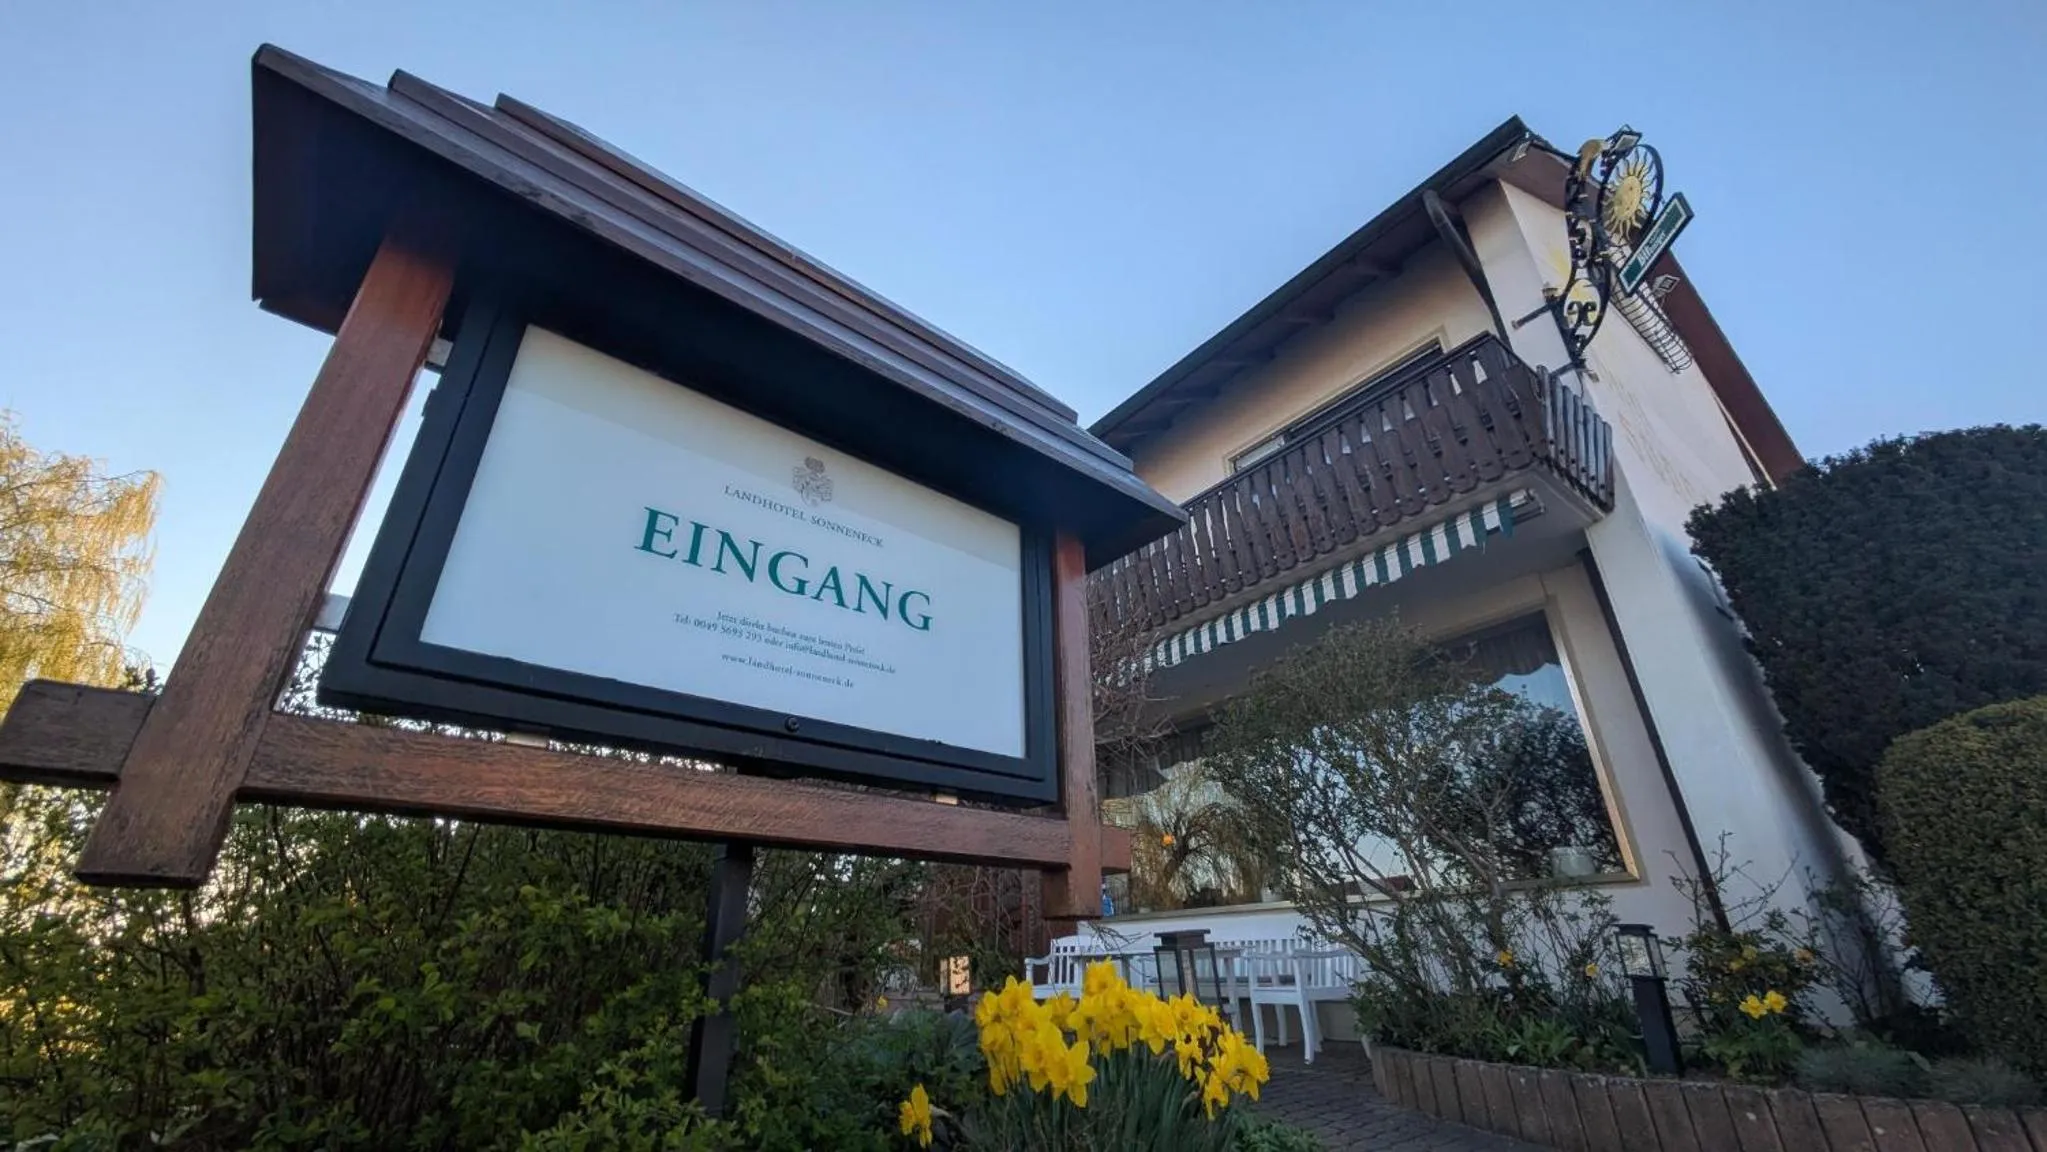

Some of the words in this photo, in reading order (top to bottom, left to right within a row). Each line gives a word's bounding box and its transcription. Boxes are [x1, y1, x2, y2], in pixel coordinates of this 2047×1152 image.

[724, 485, 807, 521] LANDHOTEL
[810, 515, 884, 548] SONNENECK
[633, 506, 934, 631] EINGANG
[764, 635, 784, 649] oder
[721, 653, 854, 688] www.landhotel-sonneneck.de
